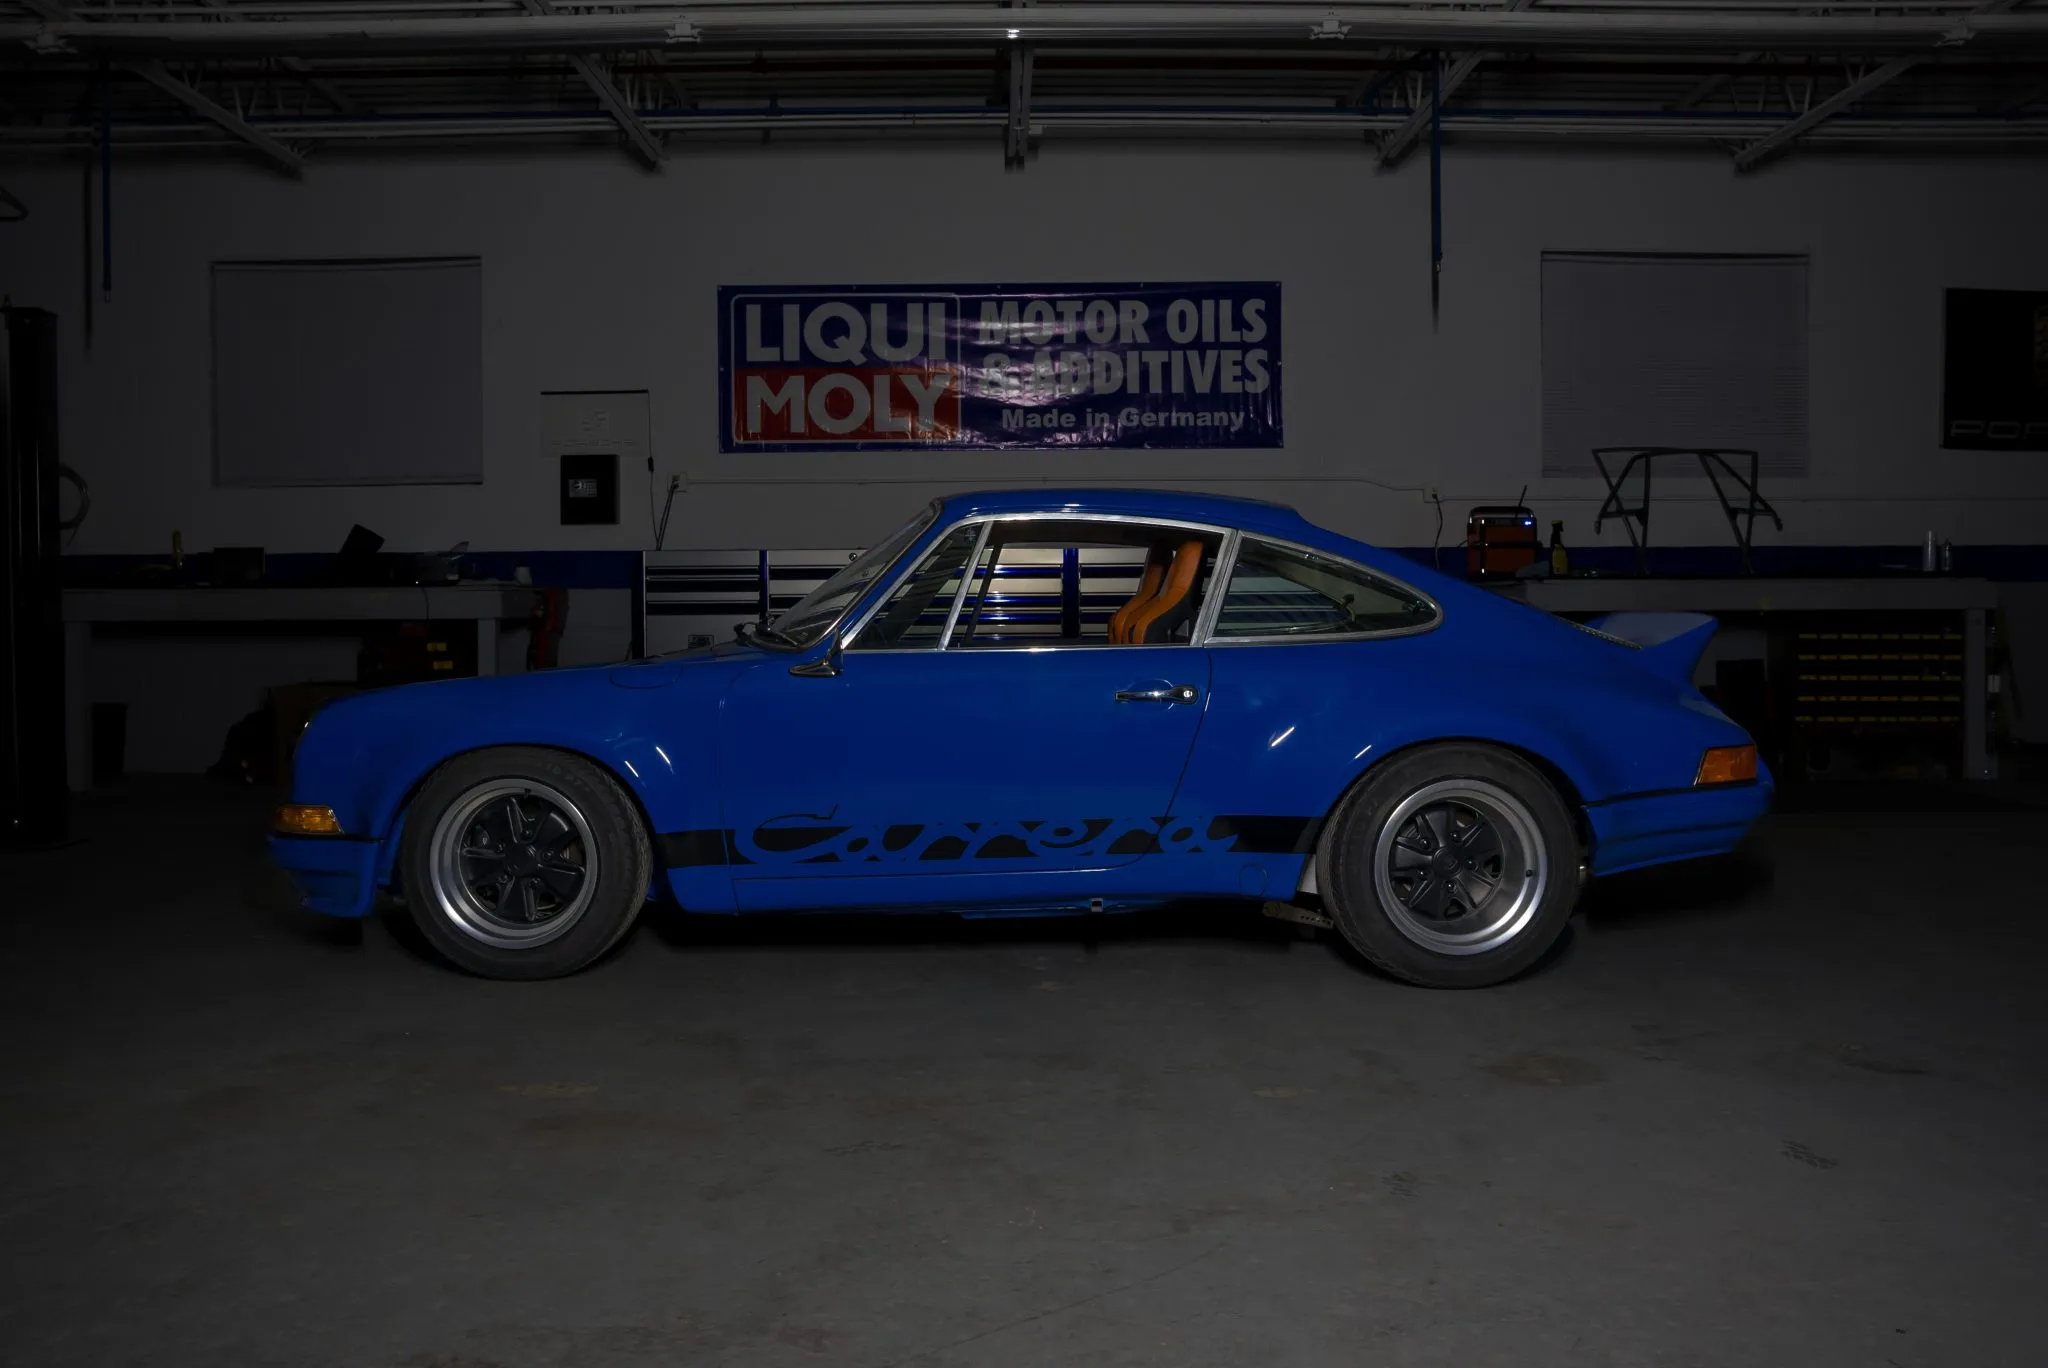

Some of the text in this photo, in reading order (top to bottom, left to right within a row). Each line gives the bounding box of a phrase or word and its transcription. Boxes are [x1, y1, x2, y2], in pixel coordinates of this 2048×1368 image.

[745, 301, 946, 367] LIQUI
[979, 298, 1268, 345] MOTOR OILS
[980, 348, 1270, 396] & ADDITIVES
[745, 372, 952, 434] MOLY
[1001, 407, 1245, 433] Made in Germany
[735, 803, 1238, 864] Carrera
